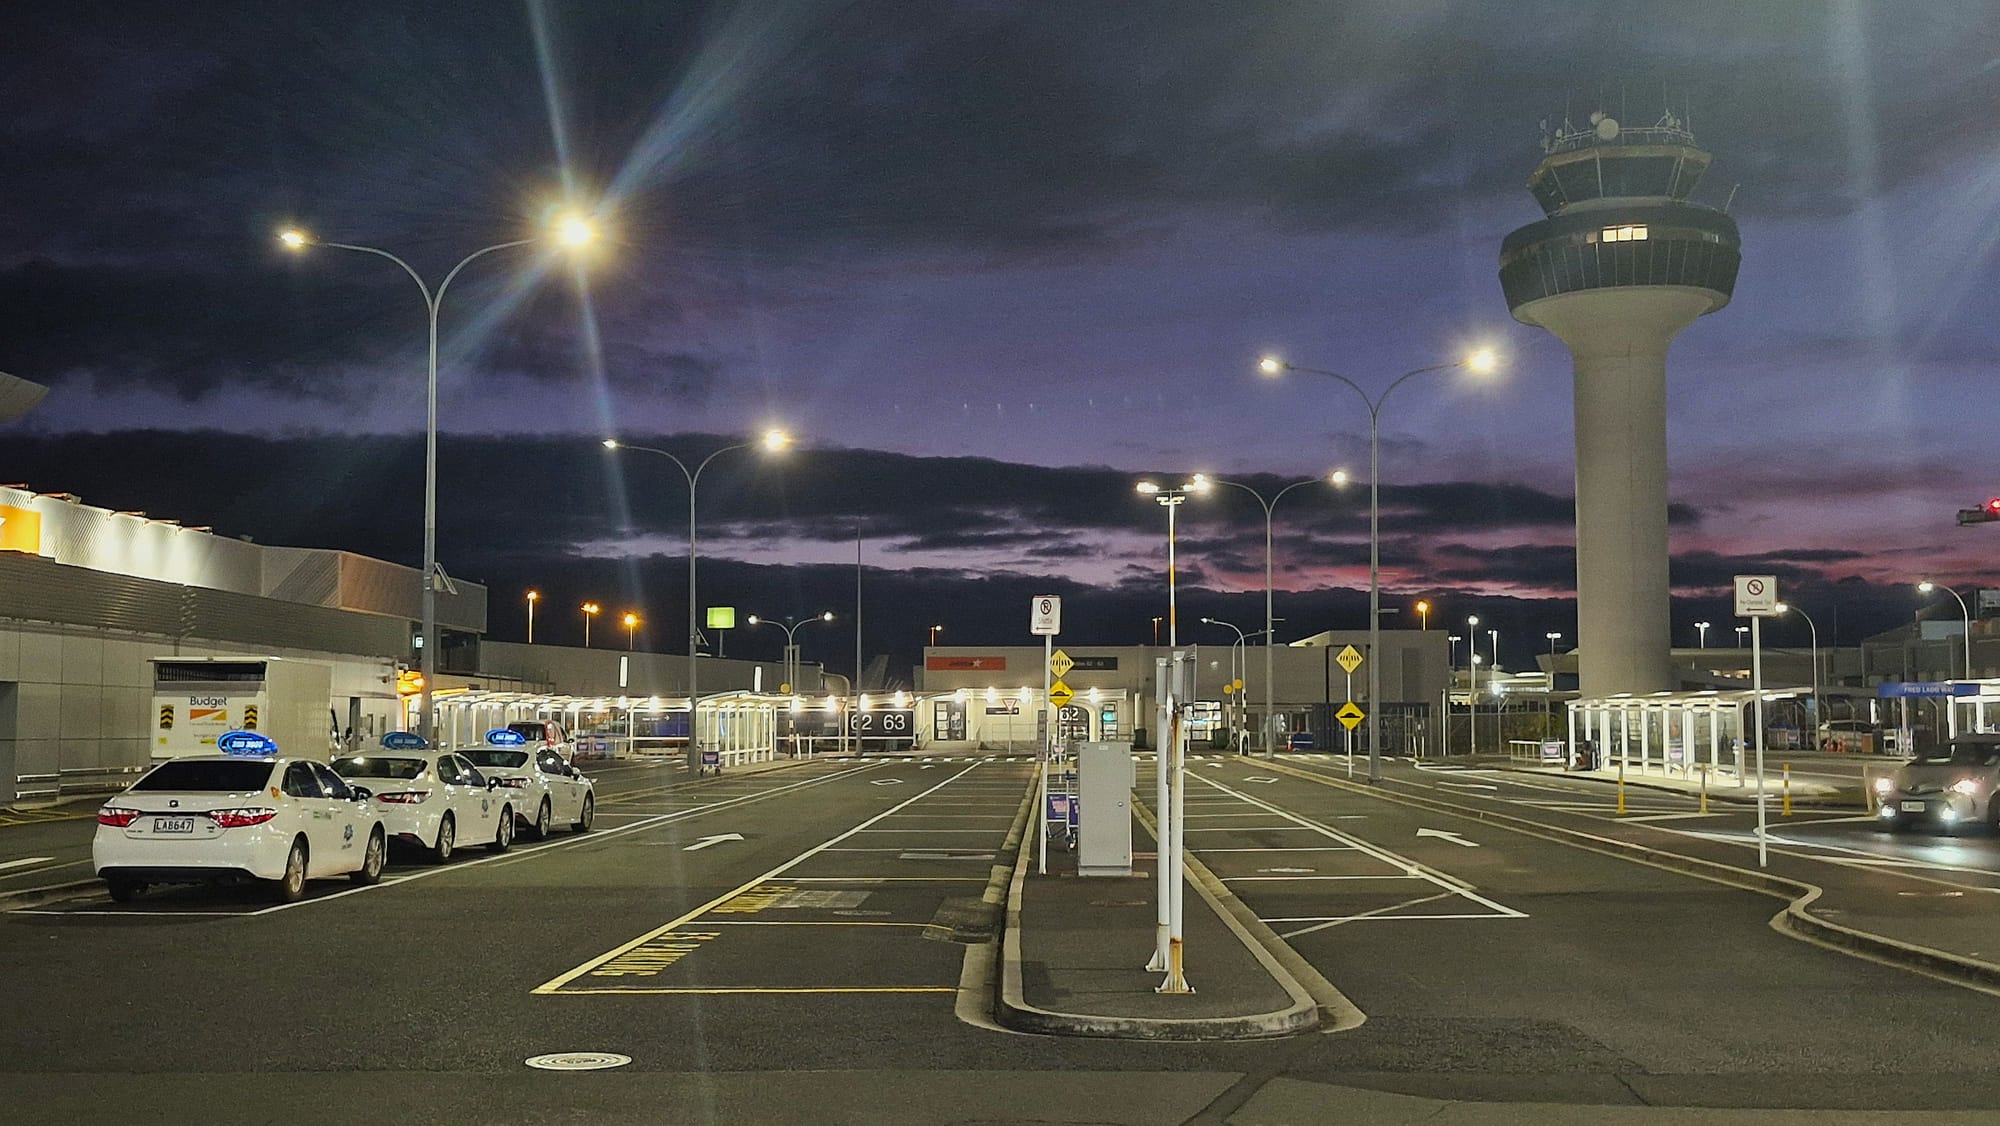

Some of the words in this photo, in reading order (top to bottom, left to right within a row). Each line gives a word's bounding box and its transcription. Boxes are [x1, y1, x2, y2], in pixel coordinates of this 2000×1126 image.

[190, 696, 227, 708] Budget
[851, 714, 873, 730] 62
[883, 714, 906, 730] 63
[156, 821, 191, 830] LAB647
